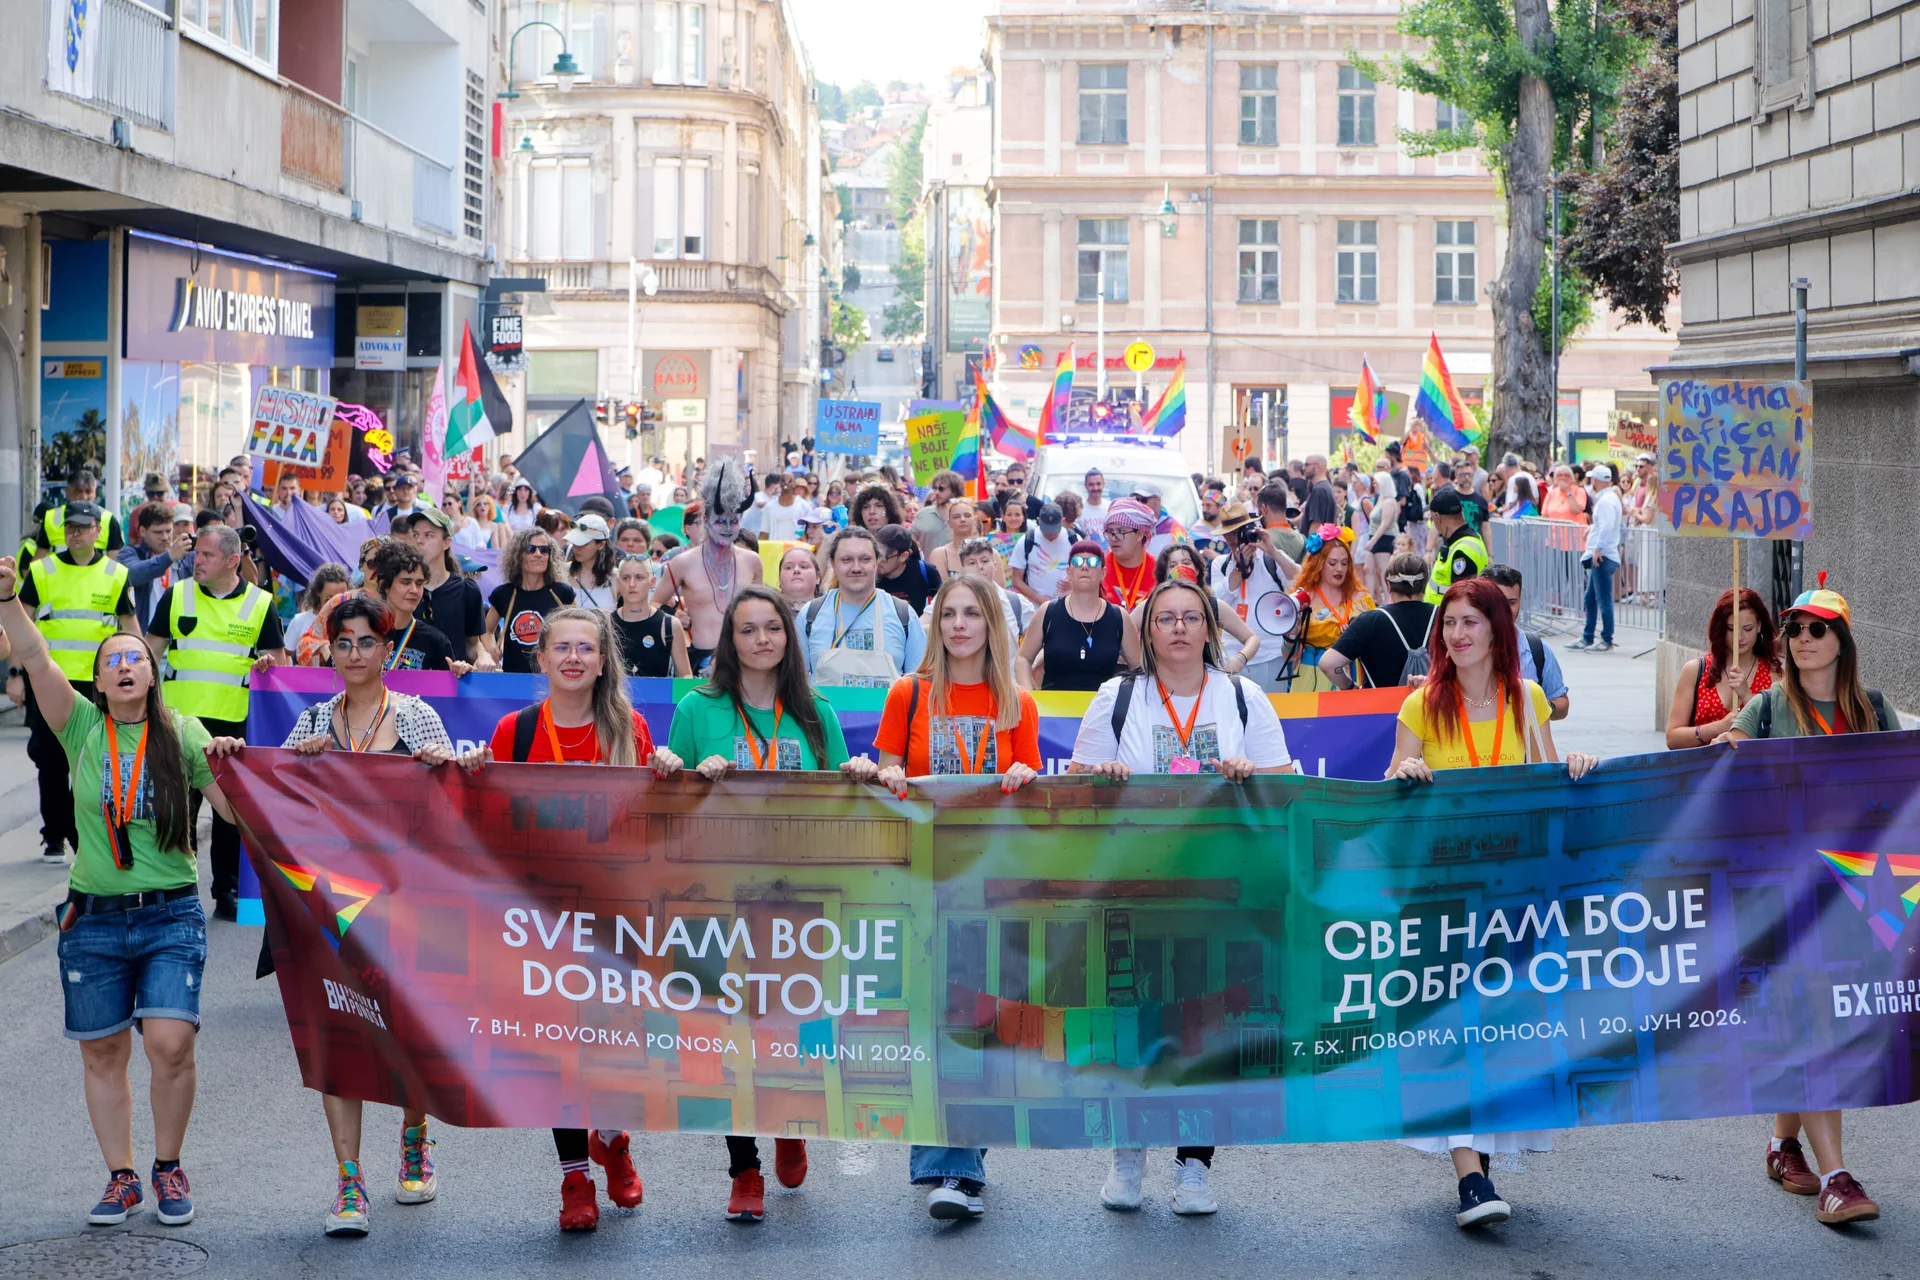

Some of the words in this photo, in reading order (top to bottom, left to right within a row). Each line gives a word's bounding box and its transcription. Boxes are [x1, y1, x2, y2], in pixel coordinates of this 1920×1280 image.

[195, 286, 223, 330] AVIO
[227, 291, 276, 335] EXPRESS
[278, 299, 314, 339] TRAVEL
[493, 317, 521, 332] FINE
[359, 342, 404, 352] ADVOKAT
[493, 331, 521, 344] FOOD
[65, 369, 97, 377] EXPRESS
[654, 372, 698, 385] BASH
[256, 389, 333, 432] NISMO
[1619, 419, 1644, 433] SAMO
[249, 421, 318, 463] FAZA
[917, 420, 951, 440] NAŠE
[920, 439, 950, 454] BOJE
[915, 459, 930, 473] NE
[933, 455, 952, 470] BLI
[1667, 443, 1801, 481] SRETAN
[1672, 483, 1802, 537] PRAJD
[502, 907, 597, 953] SVE
[614, 914, 757, 959] NAM
[771, 917, 897, 961] BOJE
[1324, 918, 1422, 961] СВЕ
[1440, 900, 1571, 952] НАМ
[1583, 888, 1706, 936] БОЈЕ
[322, 978, 352, 1014] BH
[522, 960, 702, 1011] DOBRO
[716, 973, 879, 1017] STOJE
[1333, 957, 1514, 1023] ДОБРО
[1528, 942, 1701, 994] СТОЈЕ
[1832, 982, 1873, 1018] БХ
[1874, 978, 1920, 996] ПОВО
[467, 1016, 484, 1034] 7.
[491, 1018, 528, 1038] BH.
[534, 1022, 640, 1048] POVORKA
[646, 1033, 739, 1055] PONOSA
[770, 1042, 804, 1059] 20.
[808, 1042, 864, 1062] JUNI
[871, 1043, 932, 1062] 2026.
[1291, 1040, 1306, 1057] 7.
[1313, 1037, 1346, 1056] БХ.
[1351, 1027, 1458, 1052] ПОВОРКА
[1463, 1021, 1569, 1044] ПОНОСА
[1598, 1015, 1634, 1036] 20.
[1688, 1007, 1747, 1029] 2026.
